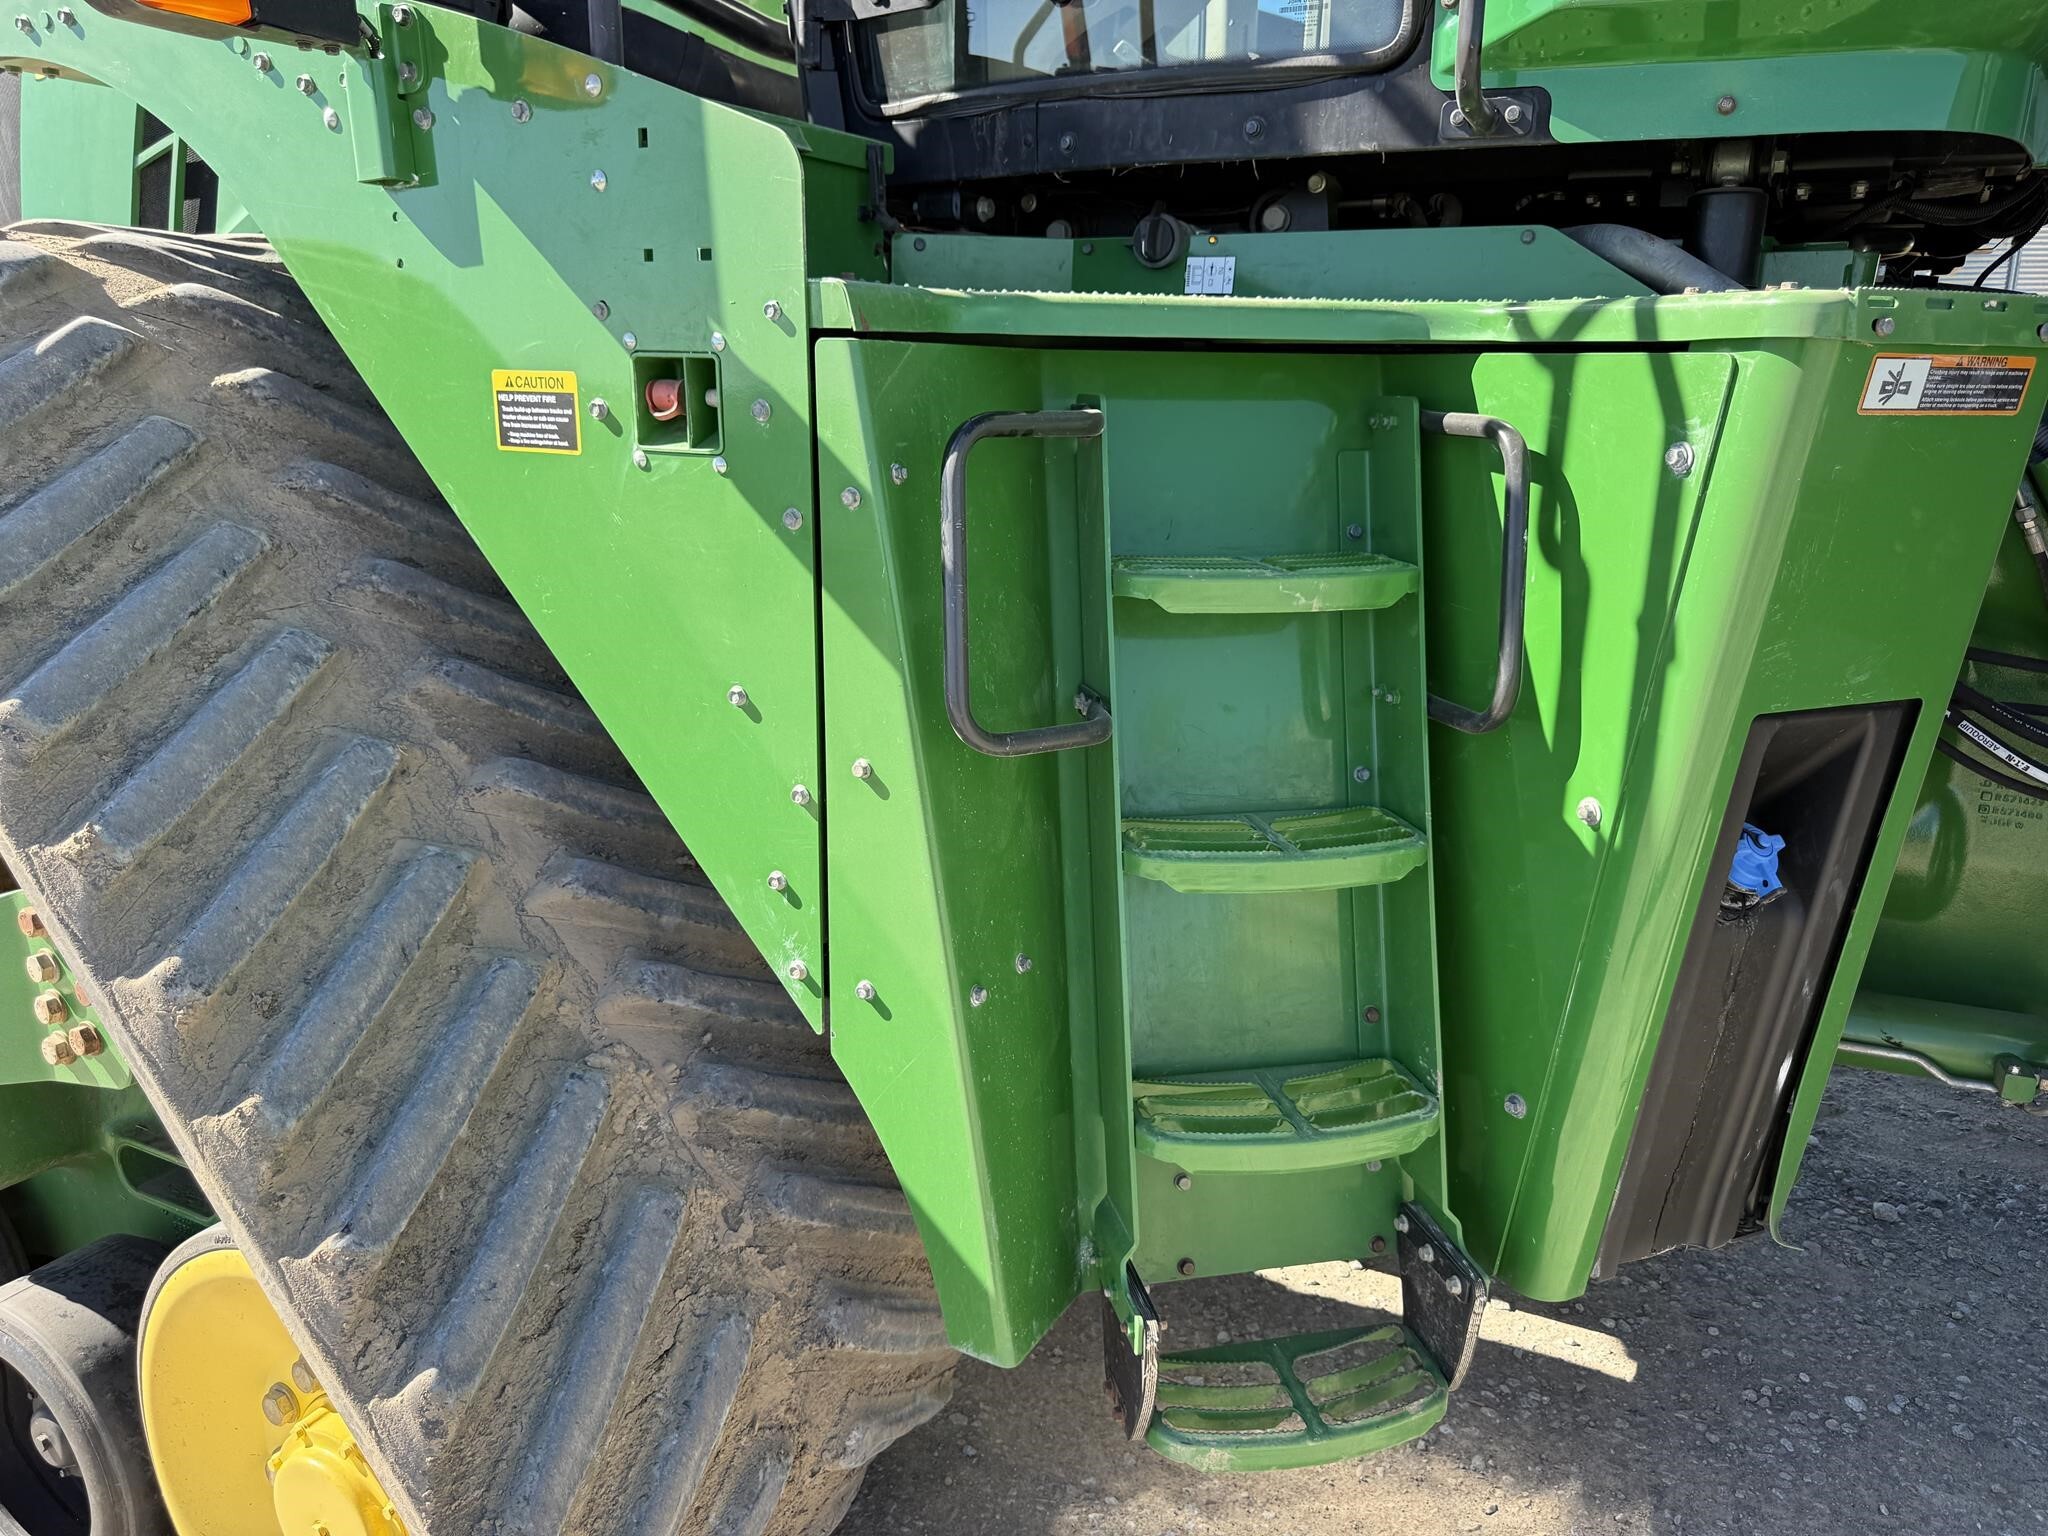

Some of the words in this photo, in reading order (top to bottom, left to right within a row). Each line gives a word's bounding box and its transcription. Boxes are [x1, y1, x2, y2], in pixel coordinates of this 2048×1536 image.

[1966, 357, 2008, 367] WARNING
[515, 376, 564, 389] CAUTION
[514, 394, 541, 402] PREVENT
[542, 395, 556, 403] FIRE
[1960, 722, 2000, 752] AEROQUIP
